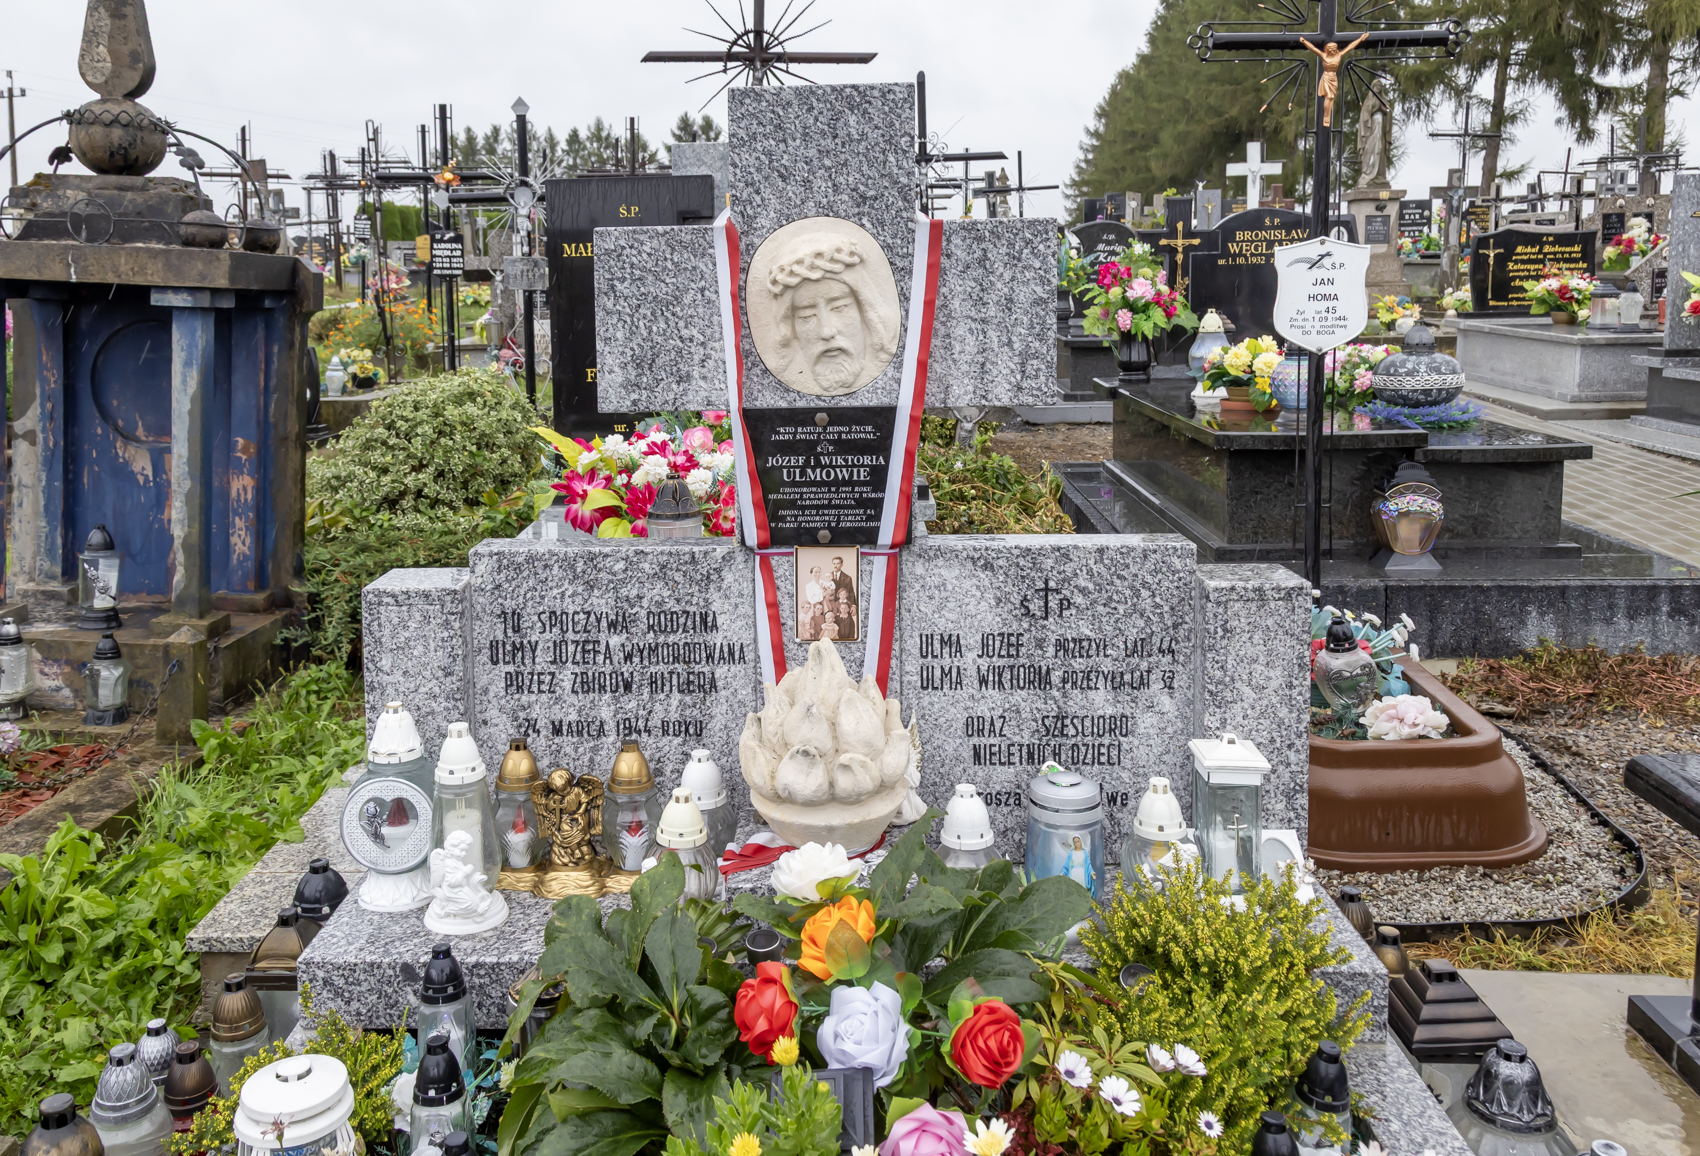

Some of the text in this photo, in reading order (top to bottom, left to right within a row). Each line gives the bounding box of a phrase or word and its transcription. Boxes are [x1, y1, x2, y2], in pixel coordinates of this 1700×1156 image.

[1235, 228, 1310, 242] BRONISŁAW
[1312, 277, 1335, 287] JAN
[1308, 293, 1339, 302] HOMA
[1324, 306, 1337, 314] 45
[766, 454, 886, 467] JÓZEF i WIKTORIA
[782, 467, 871, 482] ULMOWIE
[501, 610, 719, 635] TU SPOCZYWA RODZINA
[490, 640, 539, 666] ULMY
[622, 642, 746, 666] WYMORDOWANA
[920, 633, 963, 659] ULMA
[1158, 637, 1175, 658] 44
[504, 671, 556, 695] PRZEZ
[650, 671, 718, 694] HITLERA
[920, 665, 963, 691] ULMA
[977, 664, 1053, 691] WIKTORIA
[1130, 670, 1152, 690] LAT
[1160, 670, 1176, 690] 32
[523, 717, 704, 738] 24 MARCA 1944 ROKU
[966, 715, 1007, 738] ORAZ
[973, 741, 1121, 766] NIELETNICH DZIECI
